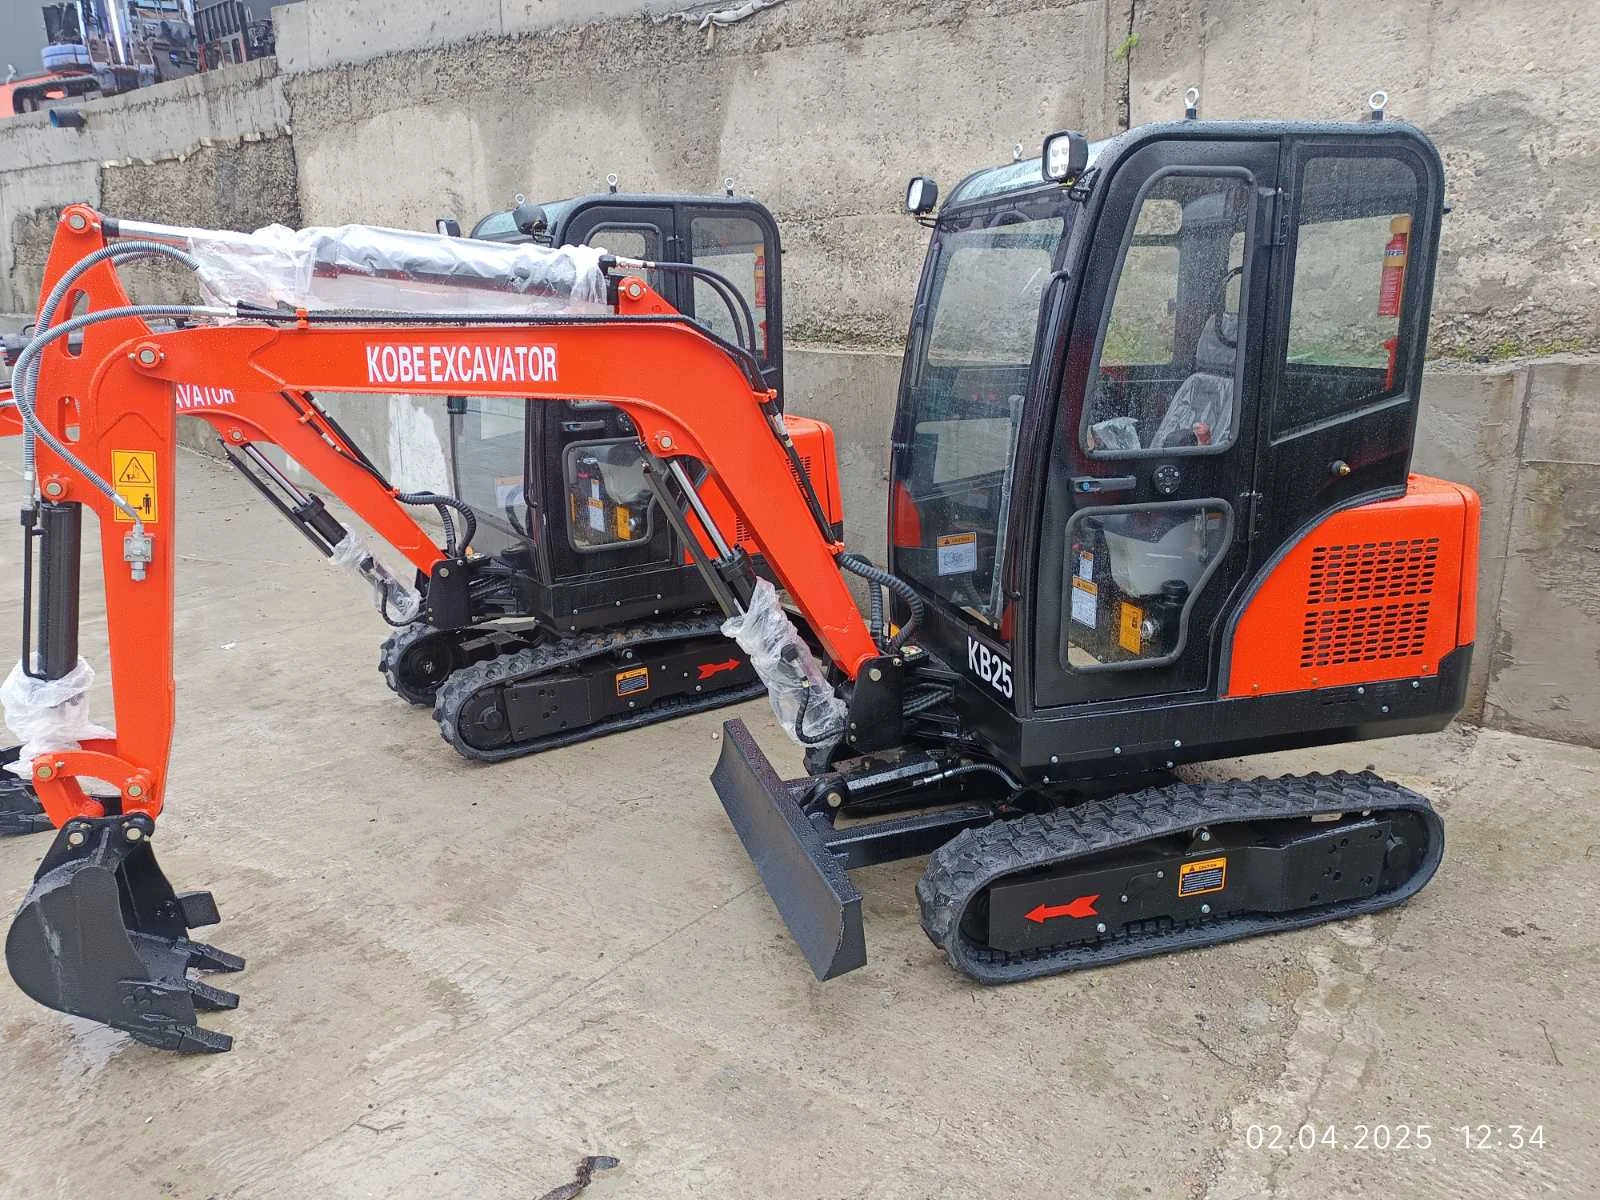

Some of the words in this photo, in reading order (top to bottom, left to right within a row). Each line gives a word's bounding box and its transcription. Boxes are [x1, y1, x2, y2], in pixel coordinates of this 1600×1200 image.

[366, 346, 426, 382] KOBE
[430, 346, 557, 382] EXCAVATOR
[968, 636, 1013, 699] KB25
